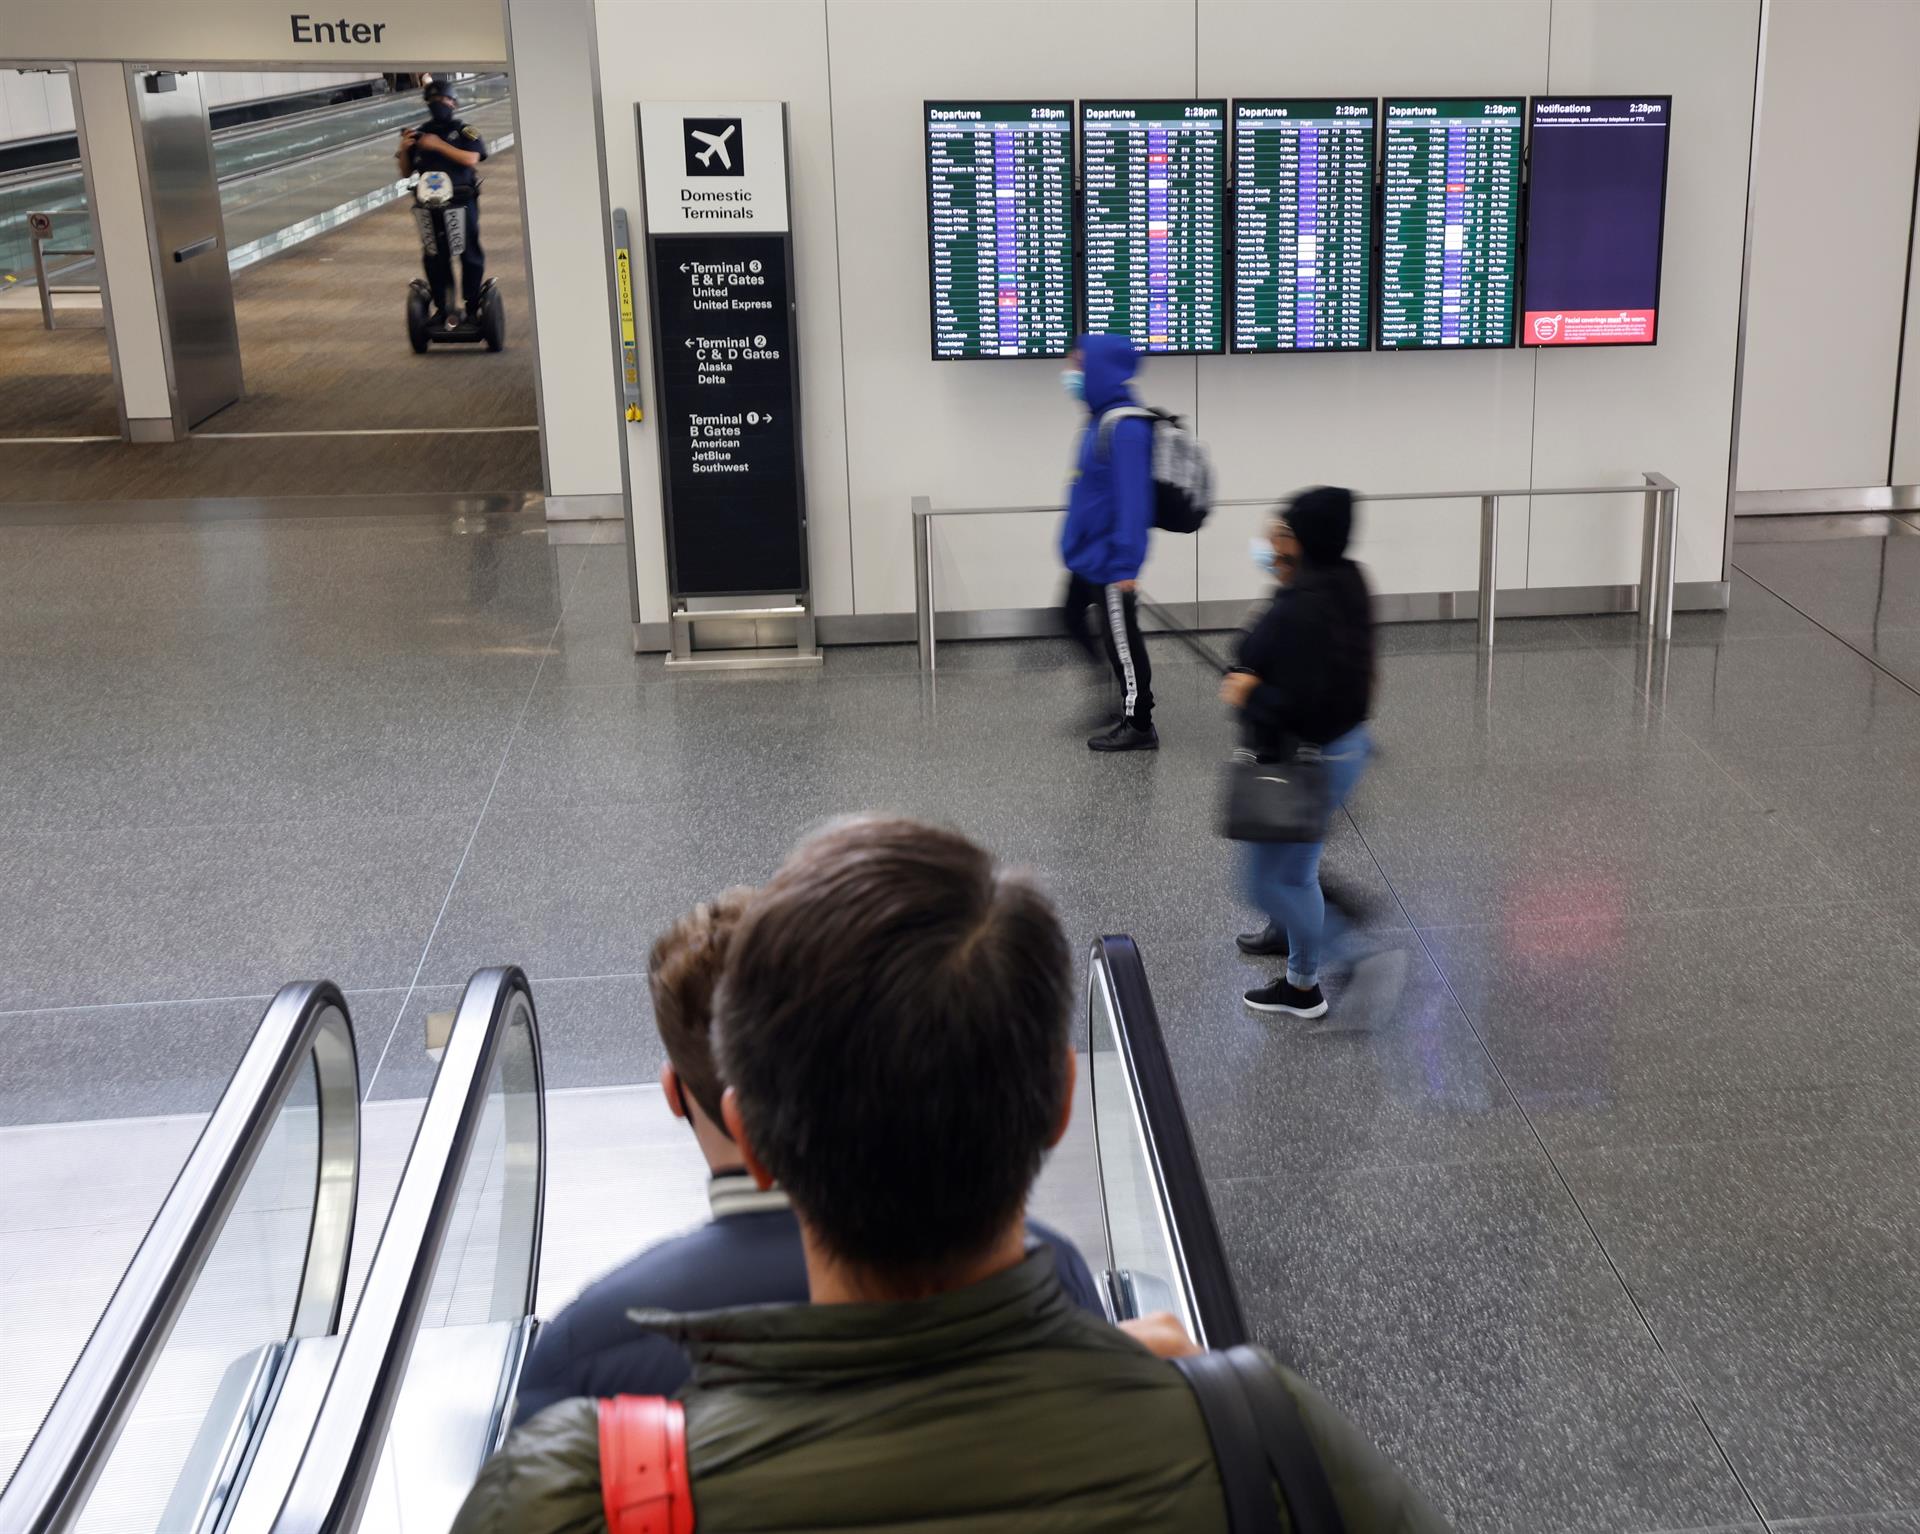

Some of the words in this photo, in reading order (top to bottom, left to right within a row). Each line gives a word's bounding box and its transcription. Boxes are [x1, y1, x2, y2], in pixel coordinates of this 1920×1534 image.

[291, 14, 385, 43] Enter
[1185, 108, 1217, 118] 2:28pm
[1239, 108, 1287, 118] Departures
[1336, 106, 1368, 116] 2:28pm
[1389, 107, 1437, 116] Departures
[1484, 105, 1516, 115] 2:28pm
[1537, 104, 1590, 113] Notifications
[1630, 104, 1661, 114] 2:28pm
[931, 110, 981, 120] Departures
[1031, 109, 1064, 119] 2:28pm
[1087, 109, 1135, 119] Departures
[681, 189, 751, 202] Domestic
[681, 206, 753, 219] Terminals
[691, 262, 744, 273] Terminal
[620, 262, 629, 304] CAUTION
[692, 274, 699, 285] E
[703, 274, 713, 285] &
[717, 274, 724, 285] F
[728, 273, 764, 285] Gates
[693, 287, 728, 297] United
[694, 300, 728, 310] United
[732, 300, 772, 310] Express
[696, 337, 749, 348] Terminal
[697, 350, 706, 360] C
[712, 349, 722, 360] &
[728, 349, 738, 359] D
[743, 349, 779, 359] Gates
[698, 362, 732, 371] Alaska
[698, 375, 725, 384] Delta
[689, 414, 742, 425] Terminal
[690, 426, 698, 436] B
[704, 426, 740, 436] Gates
[691, 439, 740, 448] American
[692, 451, 730, 460] JetBlue
[693, 463, 749, 472] Southwest
